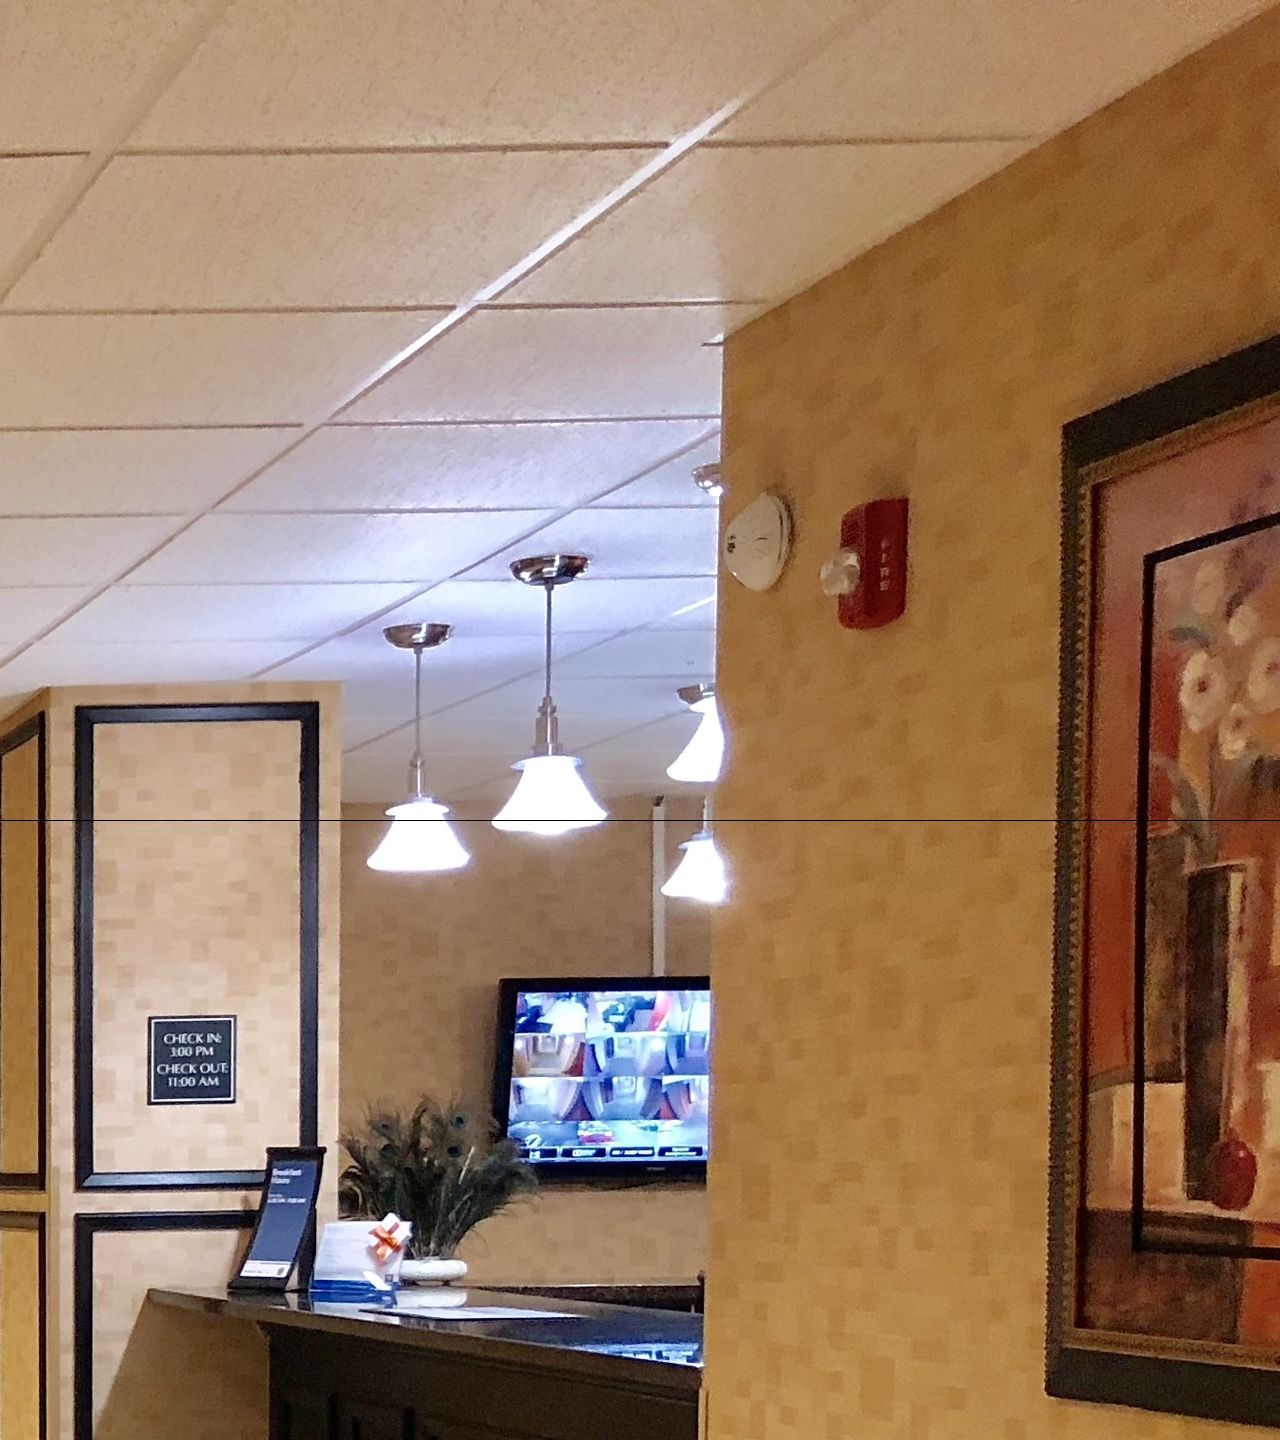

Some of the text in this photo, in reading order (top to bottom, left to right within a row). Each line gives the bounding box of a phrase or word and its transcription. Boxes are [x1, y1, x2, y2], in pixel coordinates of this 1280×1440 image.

[163, 1033, 203, 1044] CHECK
[195, 1045, 214, 1056] PM
[156, 1063, 197, 1075] CHECK
[168, 1076, 219, 1087] 11:00 AM
